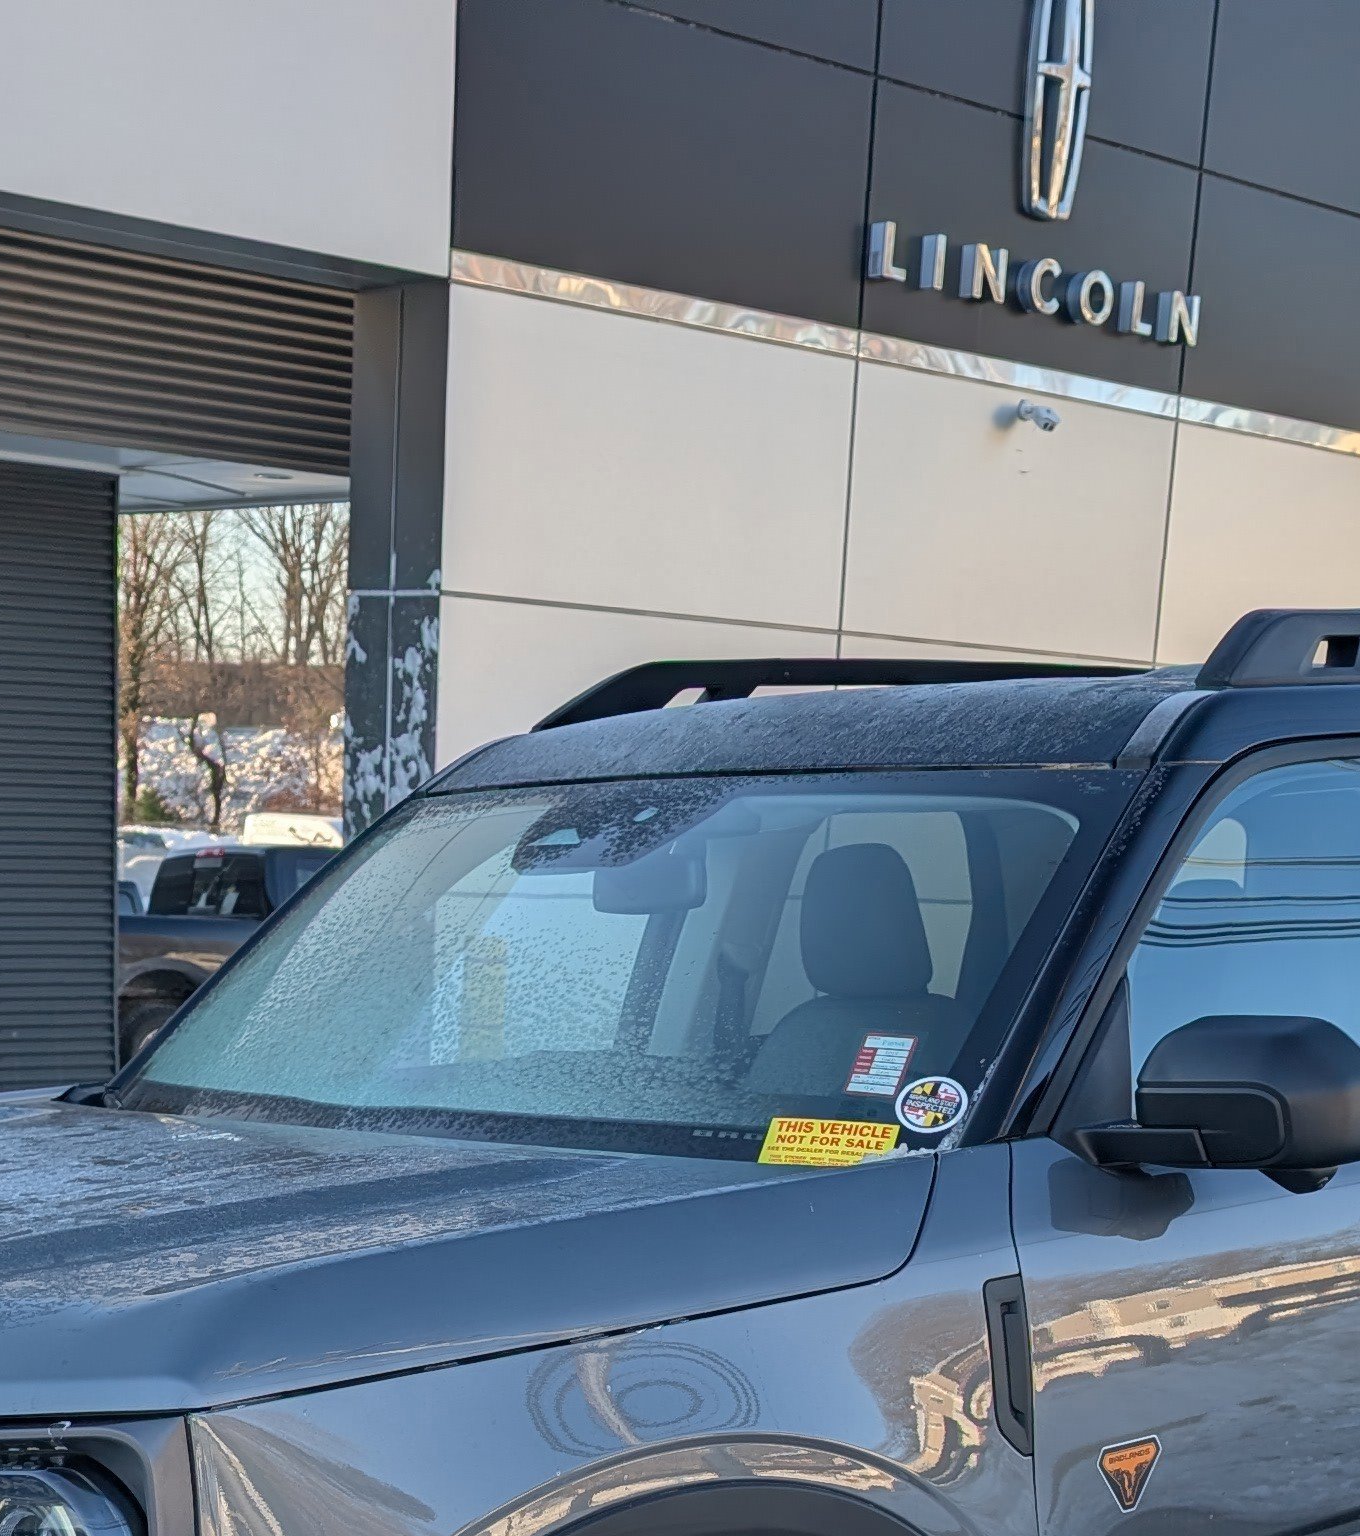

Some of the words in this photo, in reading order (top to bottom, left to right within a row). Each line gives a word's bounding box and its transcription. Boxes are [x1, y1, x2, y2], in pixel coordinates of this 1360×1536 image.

[868, 221, 1201, 347] LINCOLN
[906, 1099, 956, 1115] INSPECTED
[777, 1120, 815, 1134] THIS
[820, 1122, 893, 1139] VEHICLE
[776, 1134, 808, 1144] NOT
[810, 1136, 841, 1147] FOR
[845, 1139, 886, 1151] SALE
[1109, 1448, 1150, 1464] BADLANDS
